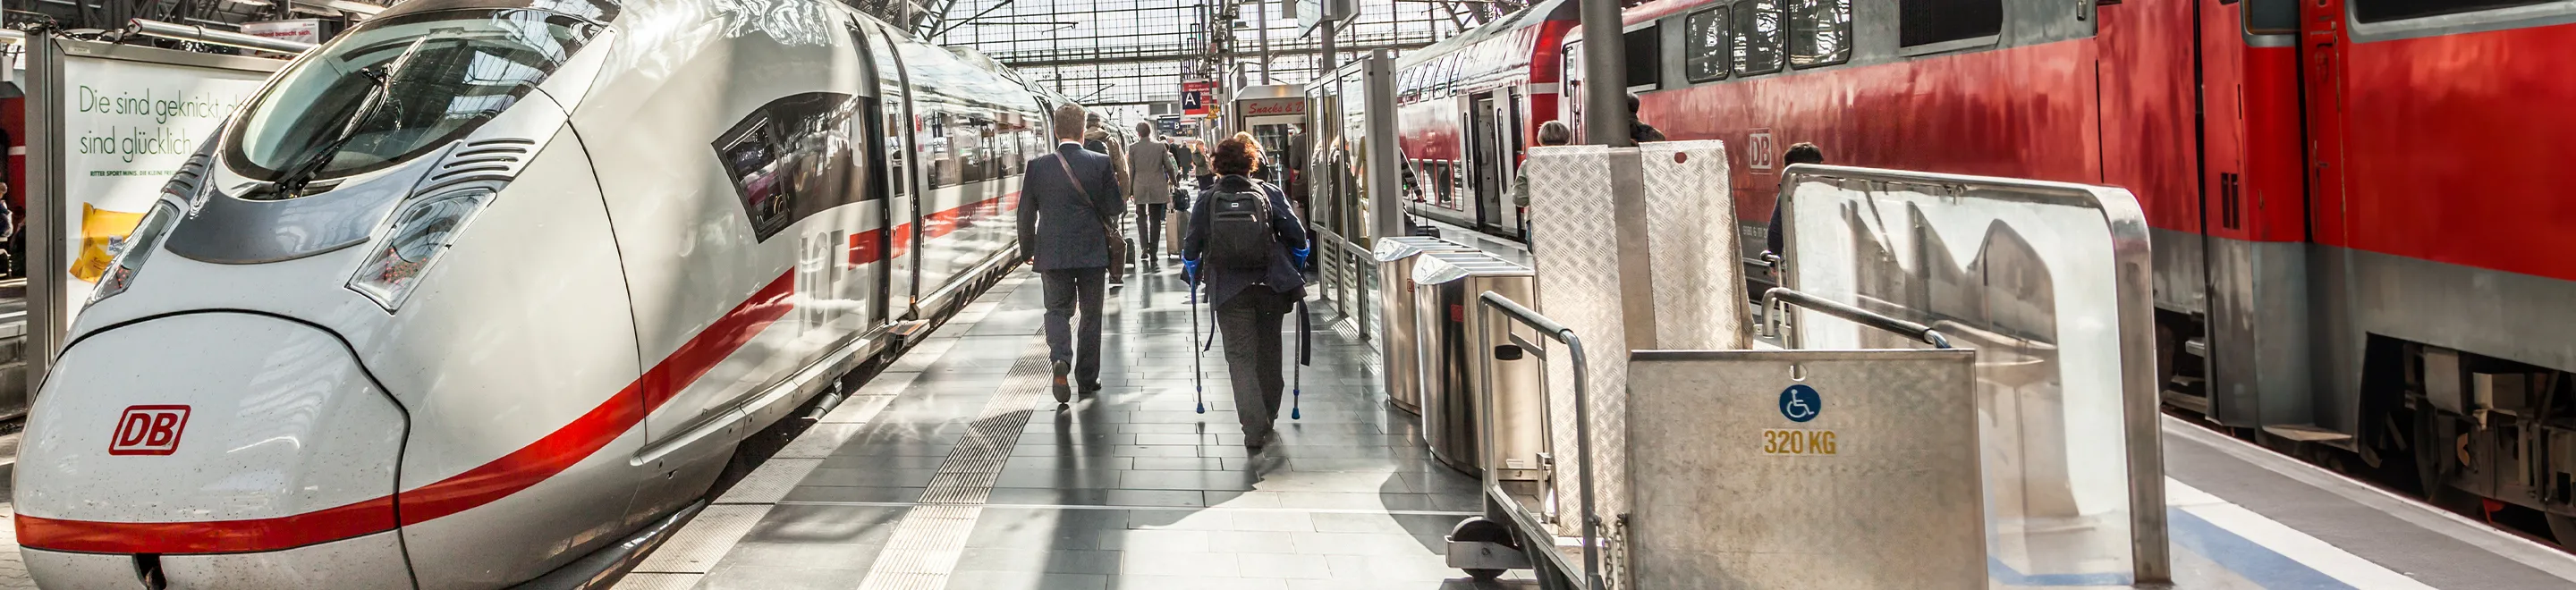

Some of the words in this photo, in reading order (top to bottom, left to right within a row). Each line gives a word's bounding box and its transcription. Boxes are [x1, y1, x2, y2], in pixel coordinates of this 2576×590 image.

[80, 85, 110, 114] Die
[115, 88, 149, 115] sind
[156, 89, 222, 124] geknickt,
[1184, 92, 1197, 105] A
[1249, 103, 1283, 114] Snacks
[1285, 103, 1292, 113] &
[1296, 101, 1305, 112] D
[1174, 122, 1180, 130] B
[80, 125, 116, 154] sind
[122, 126, 191, 163] glücklich
[1750, 136, 1771, 166] DB
[797, 228, 844, 337] ICE
[117, 411, 180, 448] DB
[1764, 430, 1803, 454] 320
[1809, 430, 1836, 454] KG
